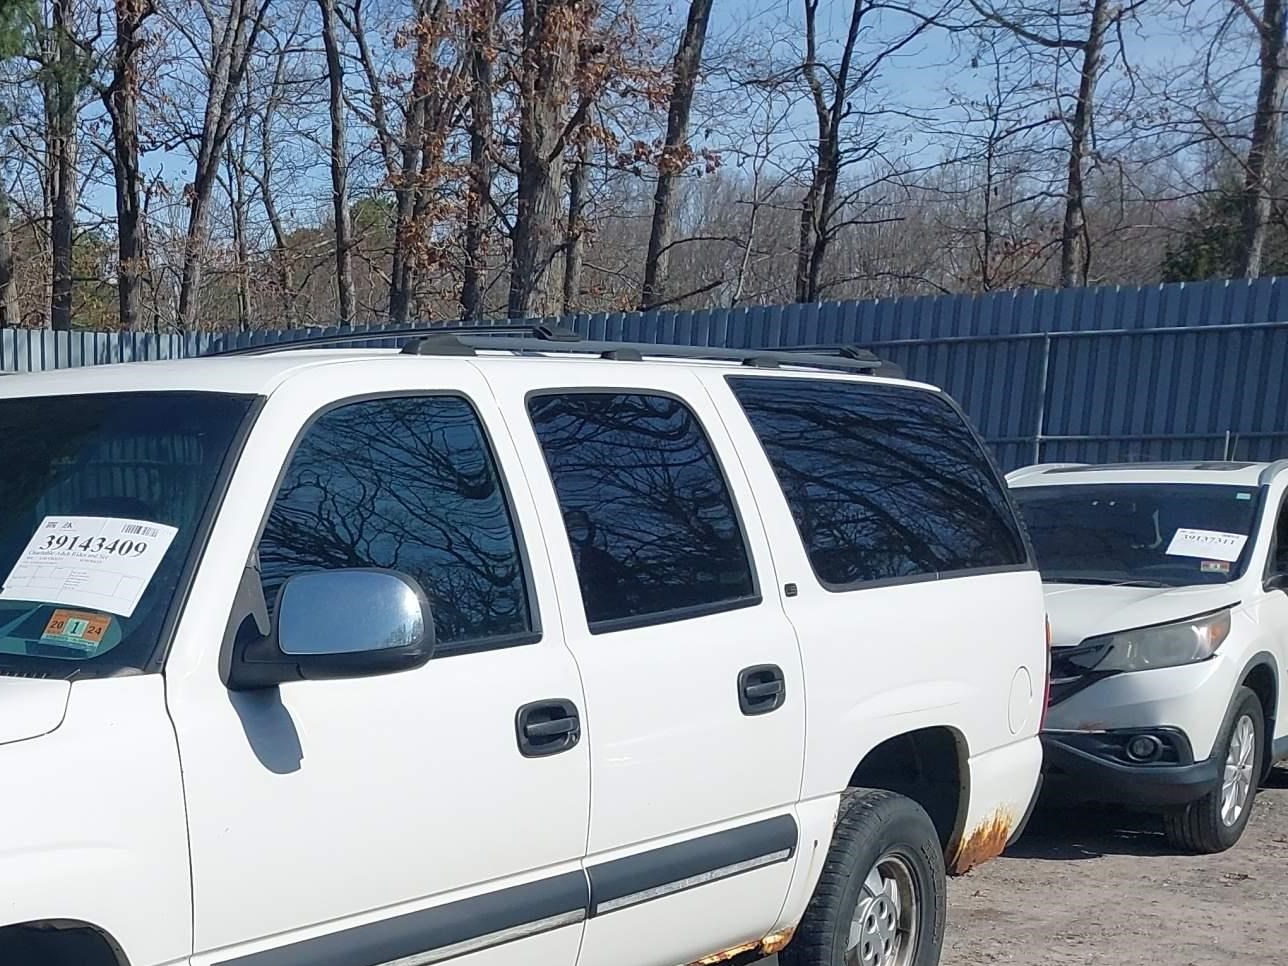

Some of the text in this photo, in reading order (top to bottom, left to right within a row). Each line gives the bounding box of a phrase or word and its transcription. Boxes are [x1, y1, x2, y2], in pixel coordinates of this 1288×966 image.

[39, 534, 149, 558] 39143409
[49, 620, 102, 636] 20 1 24
